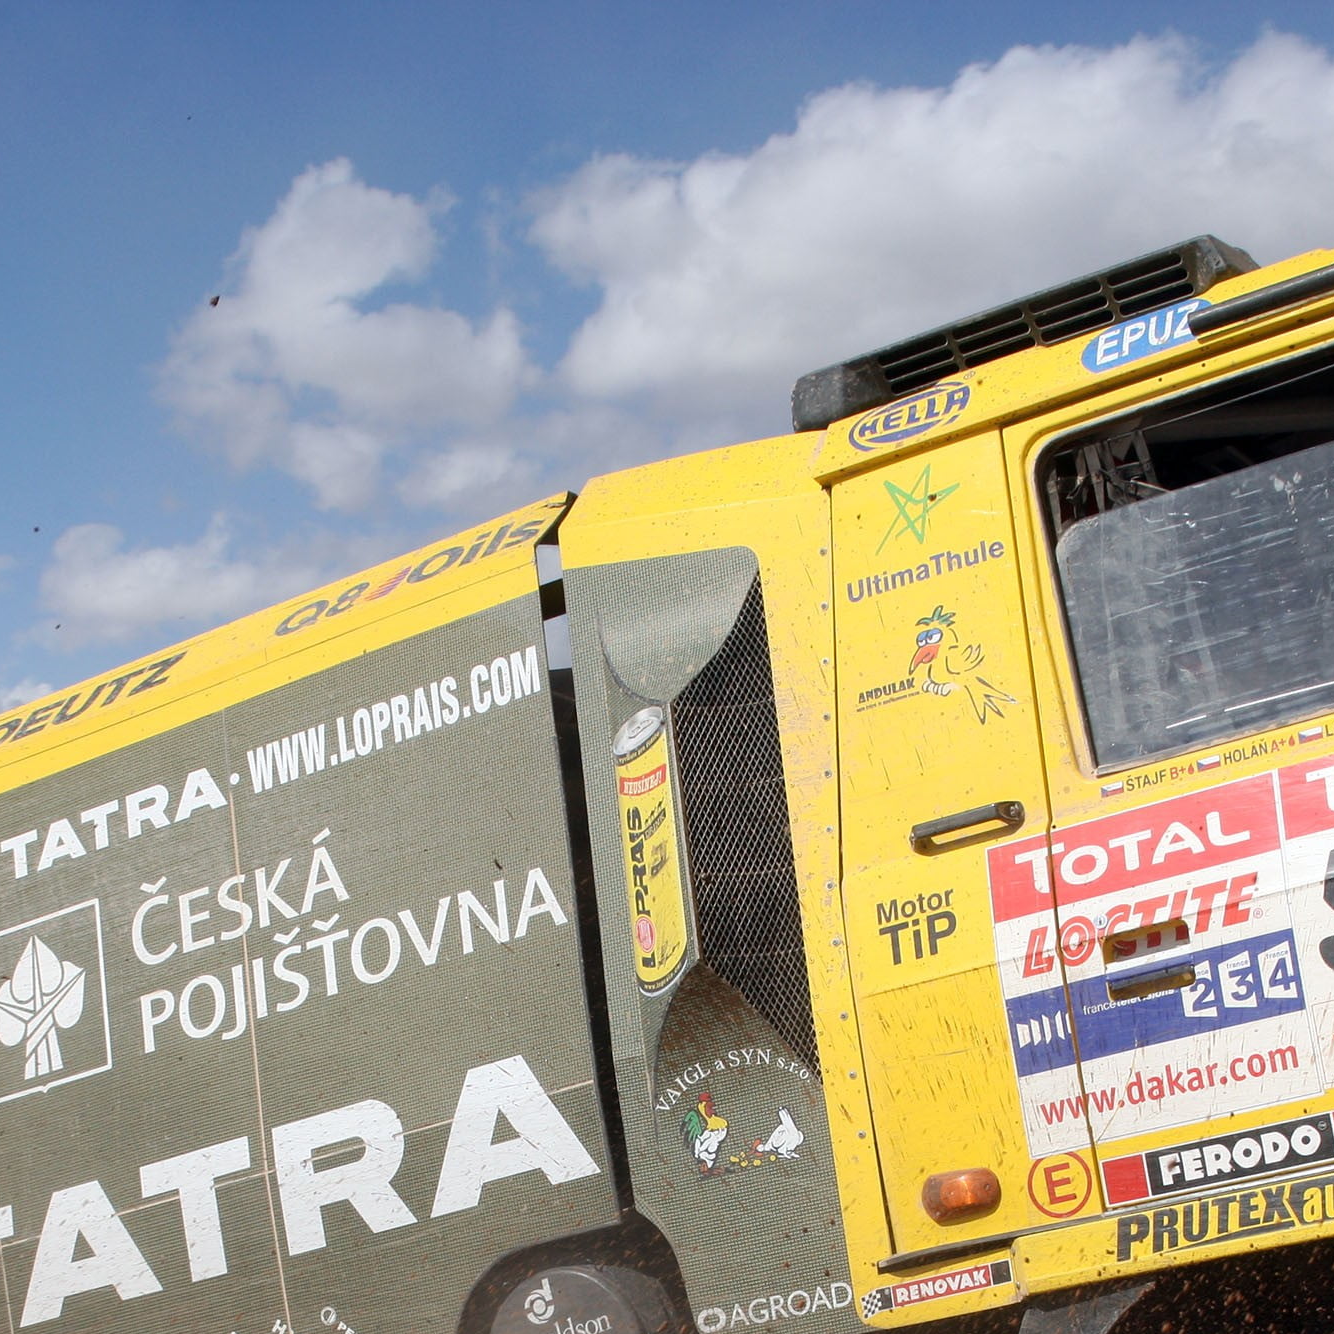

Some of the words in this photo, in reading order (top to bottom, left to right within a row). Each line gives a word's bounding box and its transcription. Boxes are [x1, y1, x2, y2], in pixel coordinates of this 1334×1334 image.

[859, 386, 971, 440] HELLA
[275, 581, 370, 636] Q8
[405, 517, 543, 583] Oils
[847, 539, 1005, 603] UltimaThule
[858, 677, 915, 704] ANDULAK
[0, 767, 228, 880] TATRA
[248, 645, 540, 792] WWW.LOPRAIS.COM
[1125, 769, 1167, 793] ŠTAJF
[1223, 738, 1269, 766] HOLÁŇ
[133, 827, 349, 964] ČESKÁ
[876, 888, 954, 925] Motor
[140, 867, 567, 1053] POJIŠŤOVNA
[1226, 960, 1248, 969] france
[1267, 950, 1288, 959] france
[1190, 978, 1214, 1011] 2
[1228, 968, 1253, 1000] 3
[1269, 958, 1294, 991] 4
[656, 1064, 711, 1113] VAIGL
[716, 1060, 726, 1070] a
[728, 1048, 772, 1067] SYN
[1039, 1042, 1299, 1126] www.dakar.com
[1044, 1163, 1073, 1205] E
[1159, 1126, 1321, 1187] FERODO
[1117, 1185, 1294, 1263] PRUTEX
[730, 1282, 852, 1328] AGROAD
[896, 1268, 988, 1304] RENOVAK
